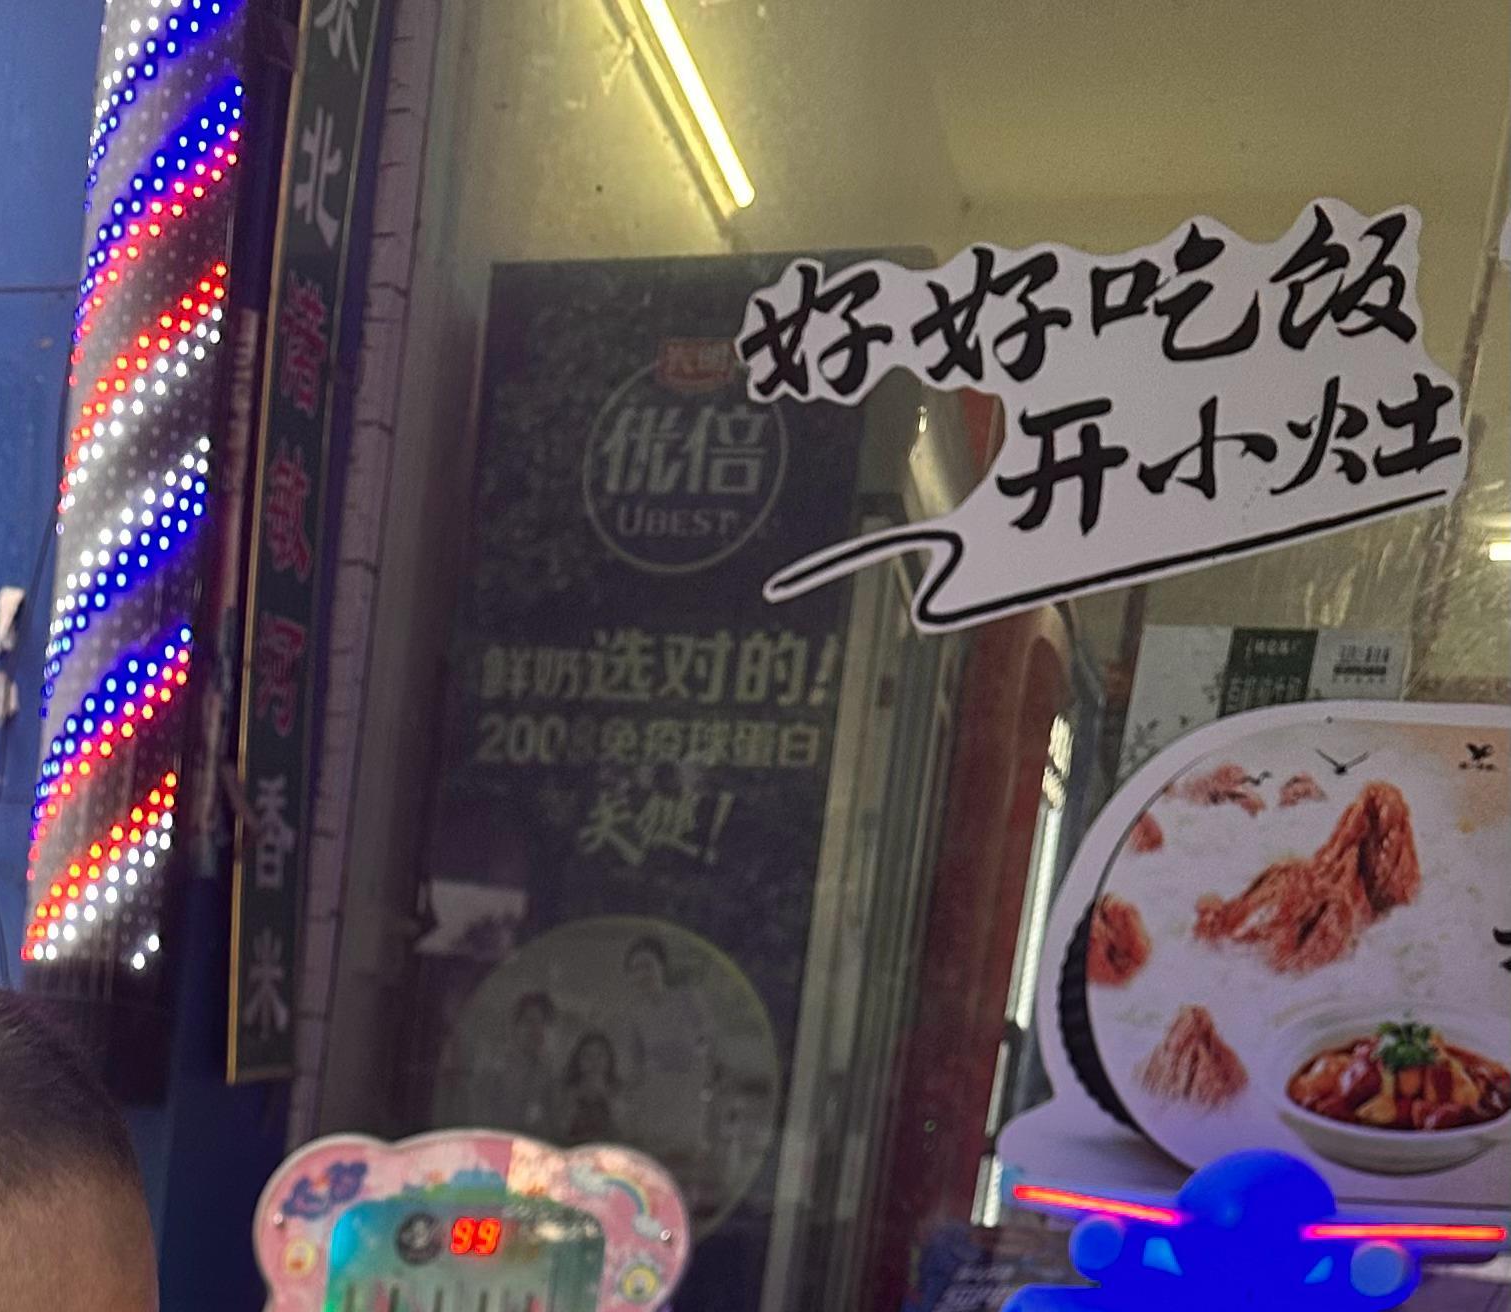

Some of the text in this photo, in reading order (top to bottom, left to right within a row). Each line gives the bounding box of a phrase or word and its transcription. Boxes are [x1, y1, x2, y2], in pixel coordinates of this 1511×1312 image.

[741, 204, 1418, 397] 好好吃饭
[601, 403, 771, 494] 优倍
[996, 374, 1462, 535] 开小灶
[450, 1217, 502, 1255] 99
